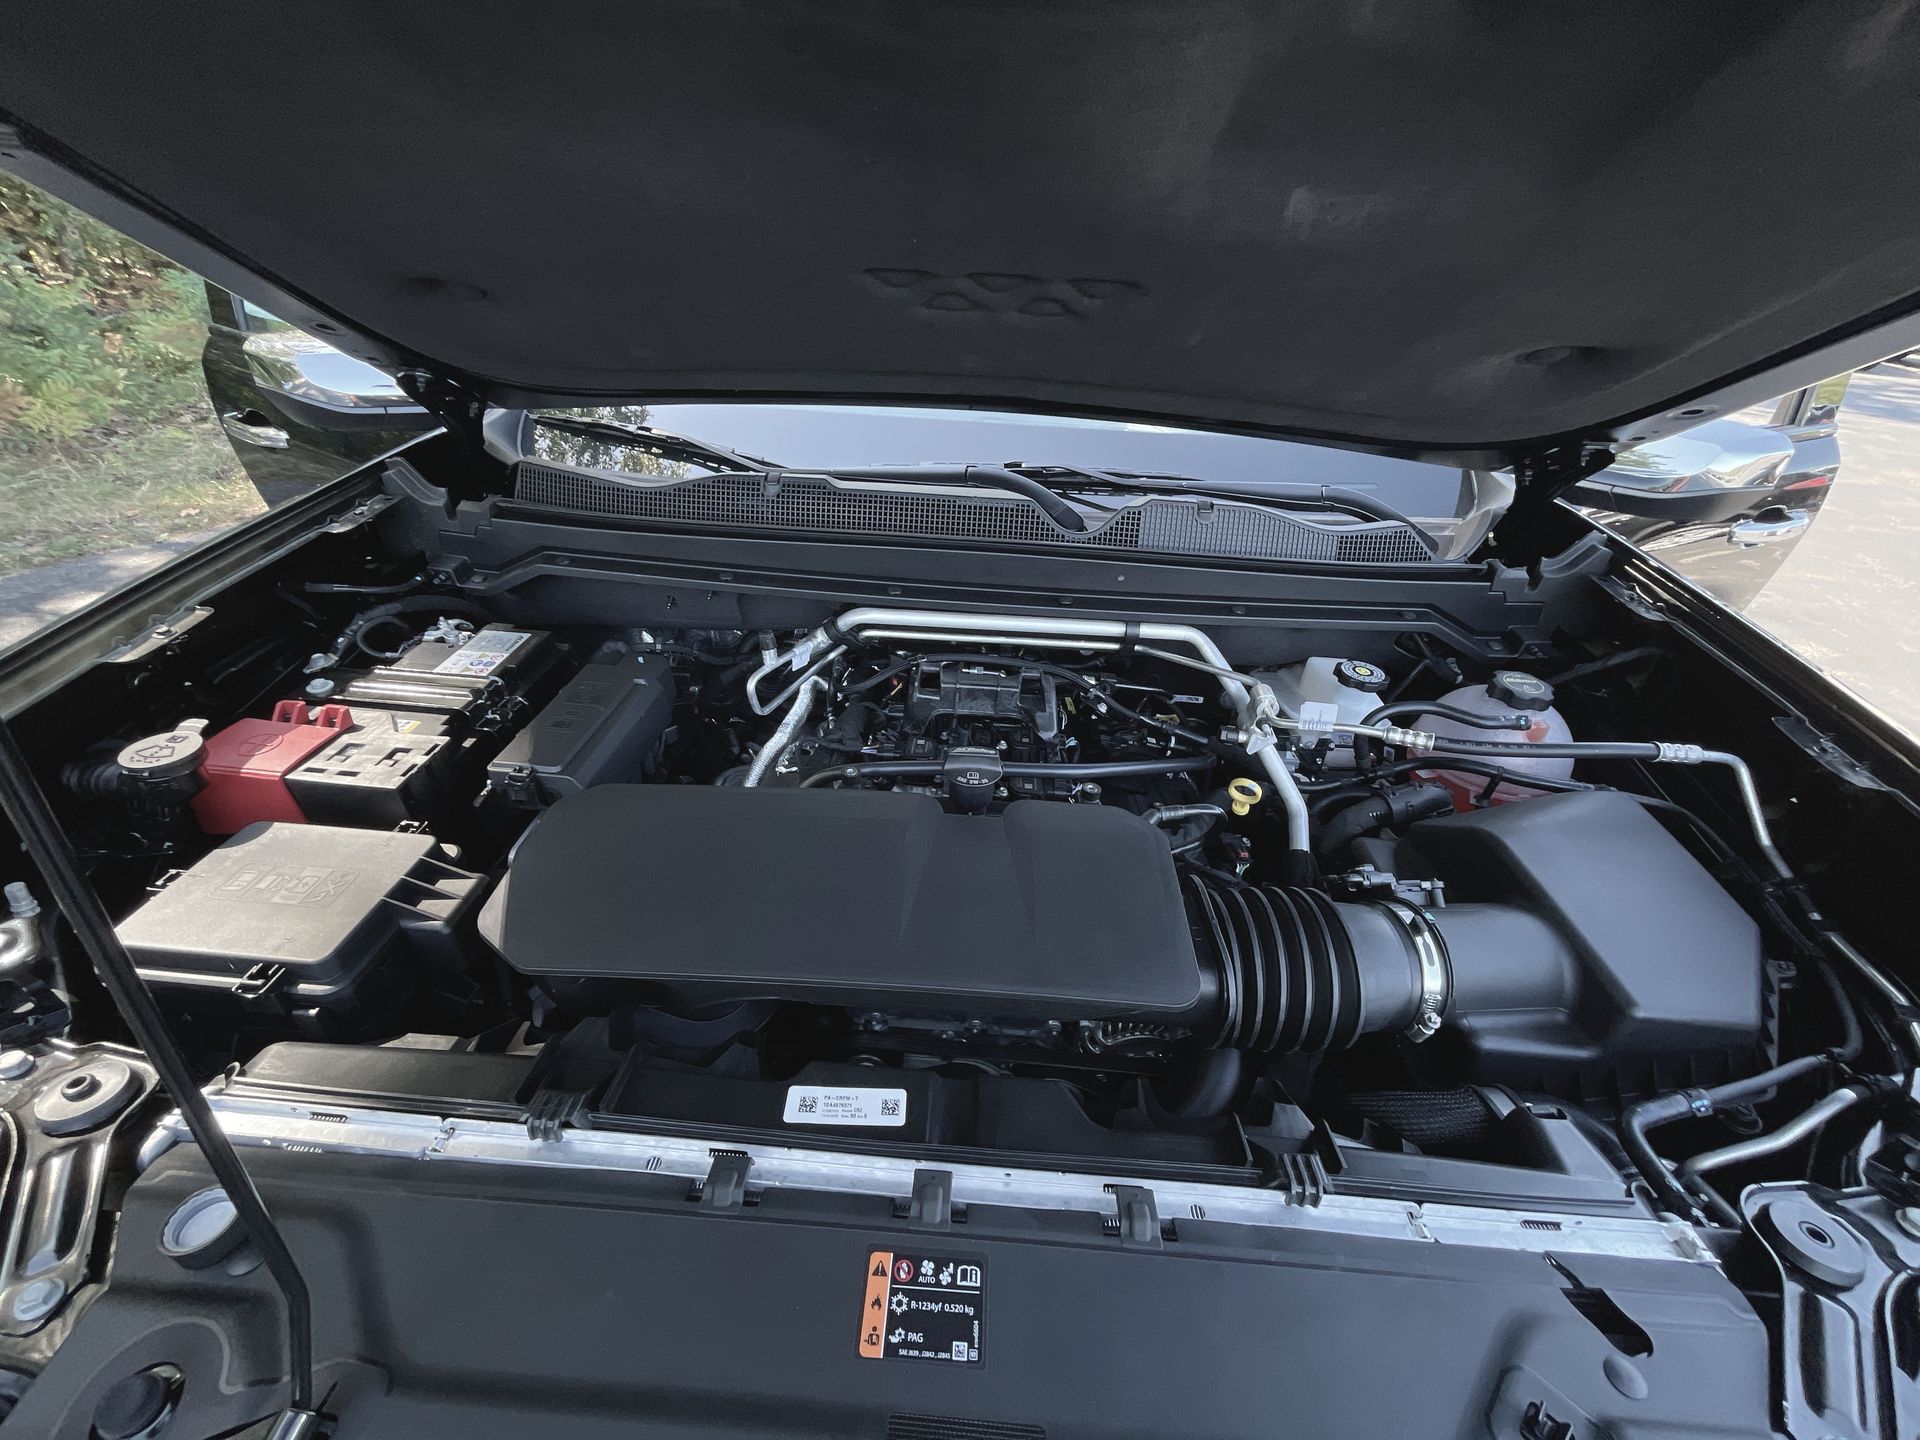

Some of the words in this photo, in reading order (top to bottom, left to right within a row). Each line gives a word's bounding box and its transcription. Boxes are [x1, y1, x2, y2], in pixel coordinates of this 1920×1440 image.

[918, 1275, 936, 1284] AUTO
[910, 1301, 942, 1313] R-1234yf
[944, 1304, 964, 1313] 0.520
[964, 1305, 974, 1316] kg
[907, 1332, 924, 1343] PAG
